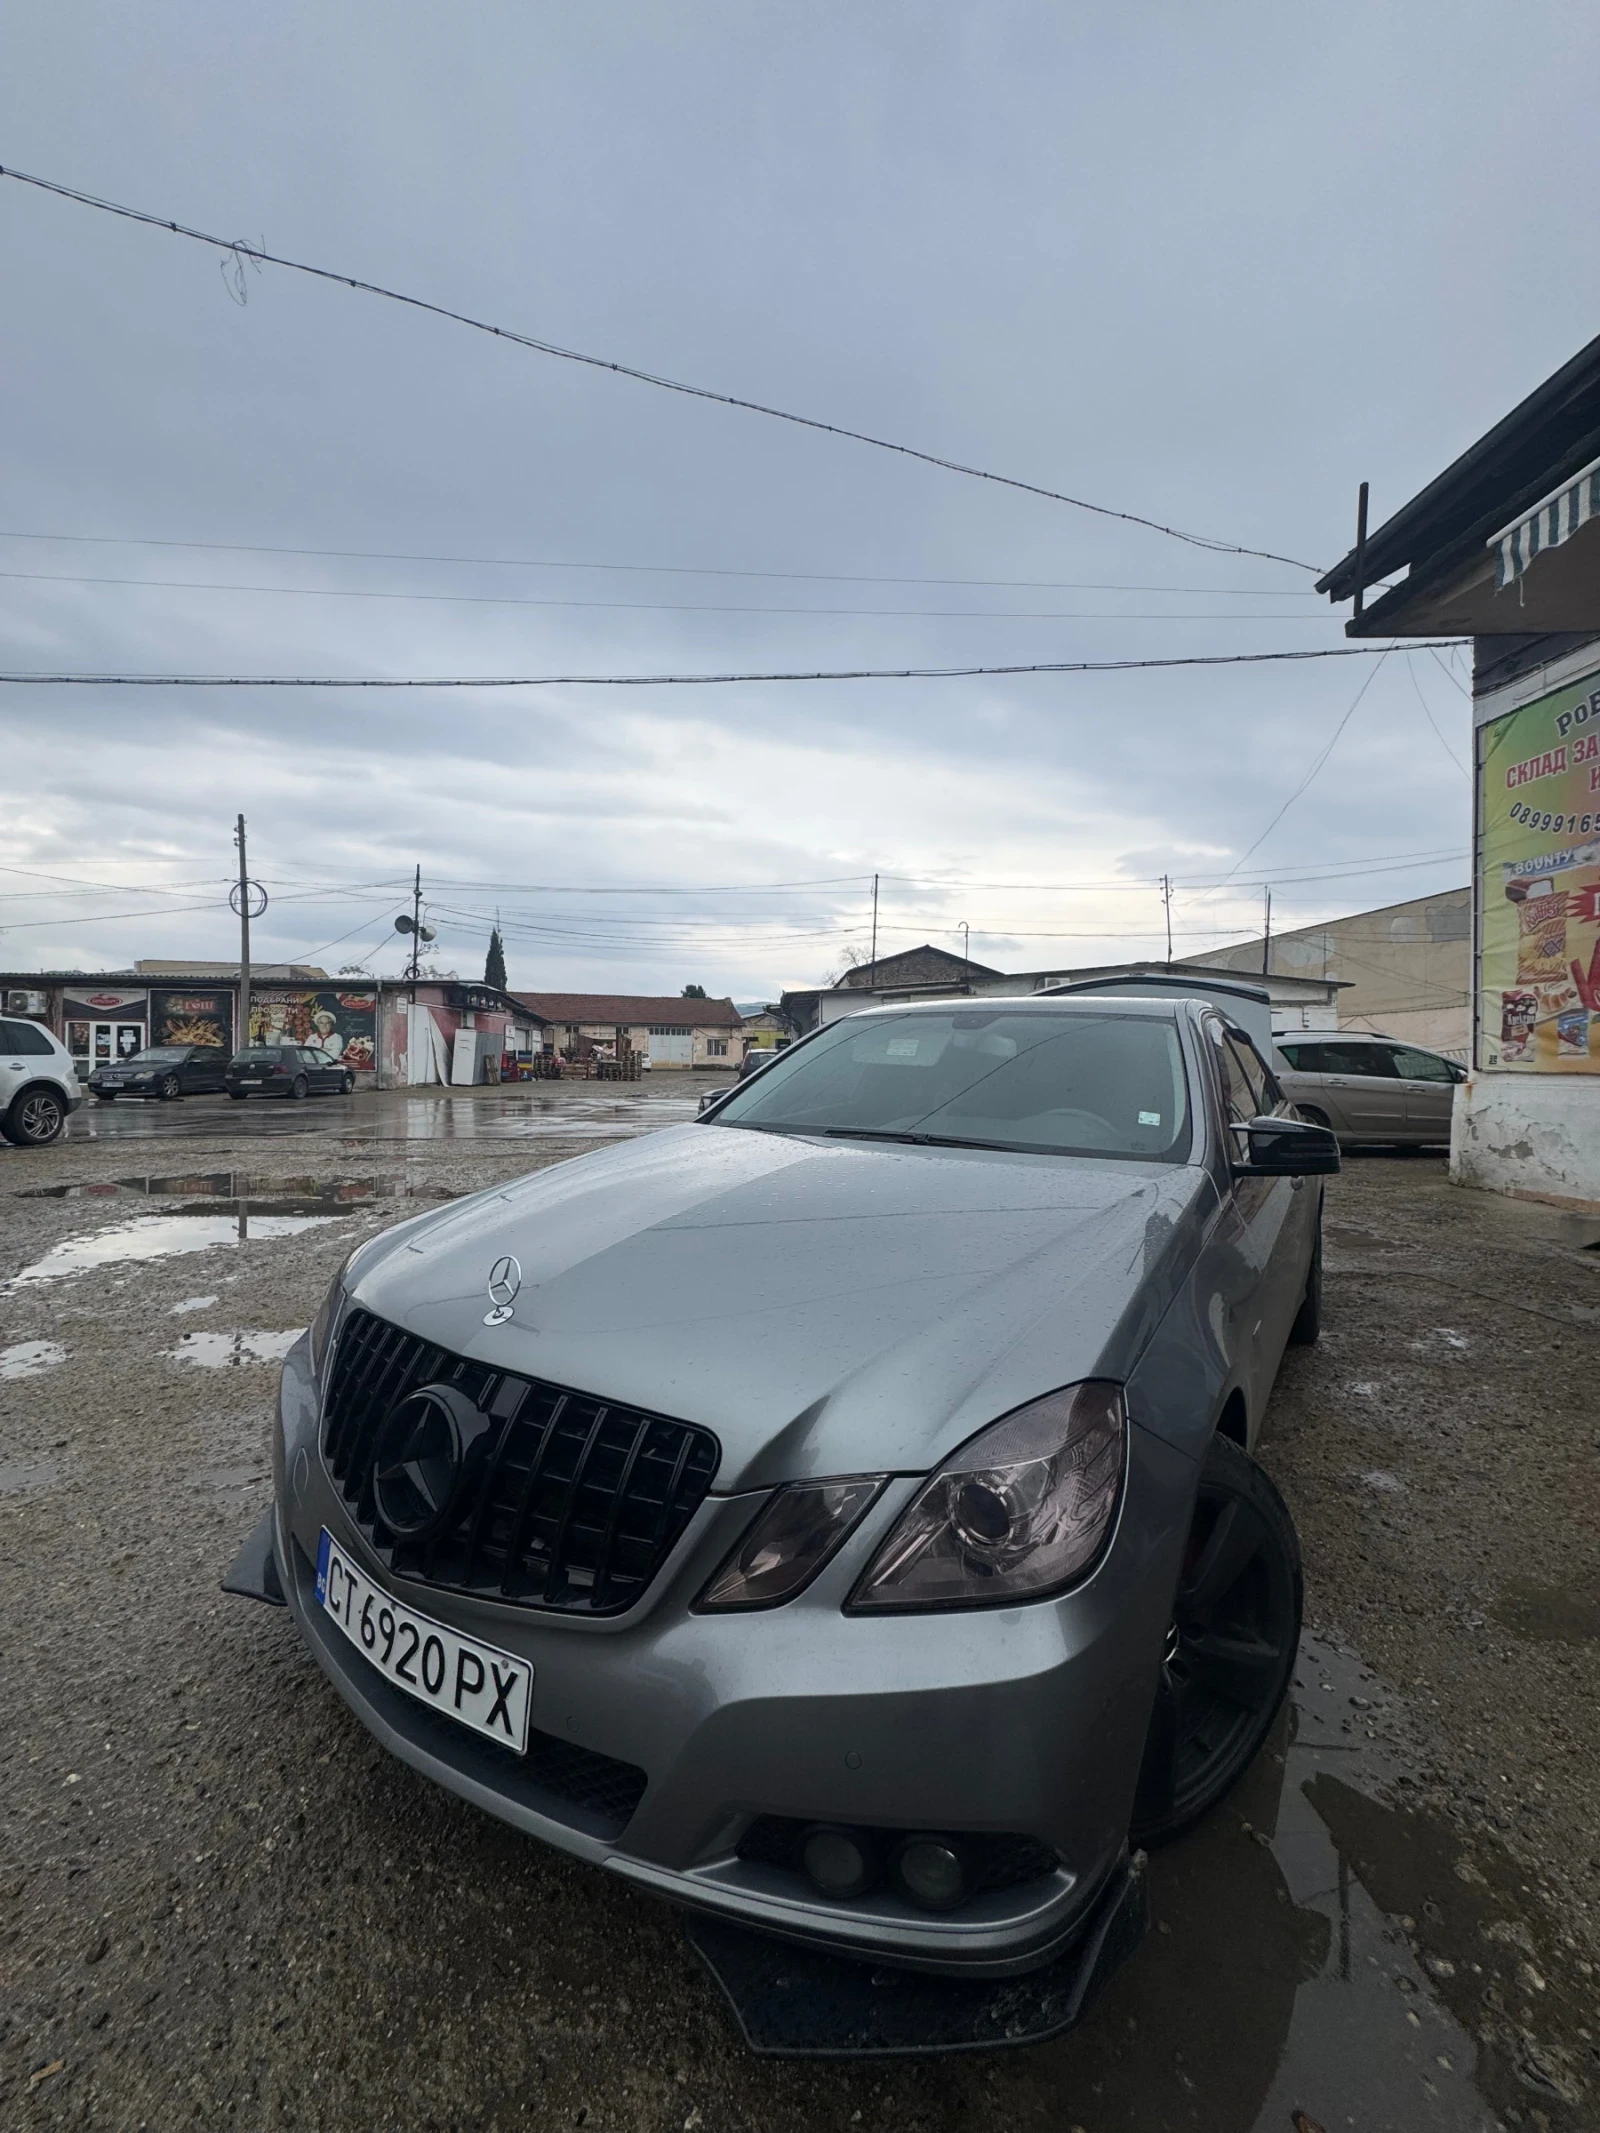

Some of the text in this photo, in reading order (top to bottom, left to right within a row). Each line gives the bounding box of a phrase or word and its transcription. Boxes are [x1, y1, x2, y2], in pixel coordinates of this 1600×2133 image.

[1506, 734, 1599, 789] СКЛАД ЗА
[1509, 801, 1600, 834] 08999165
[1514, 849, 1573, 875] BOUNTY
[1524, 901, 1559, 928] Ruffles
[250, 995, 299, 1004] ПОДБРАНИ
[316, 1572, 327, 1593] BG
